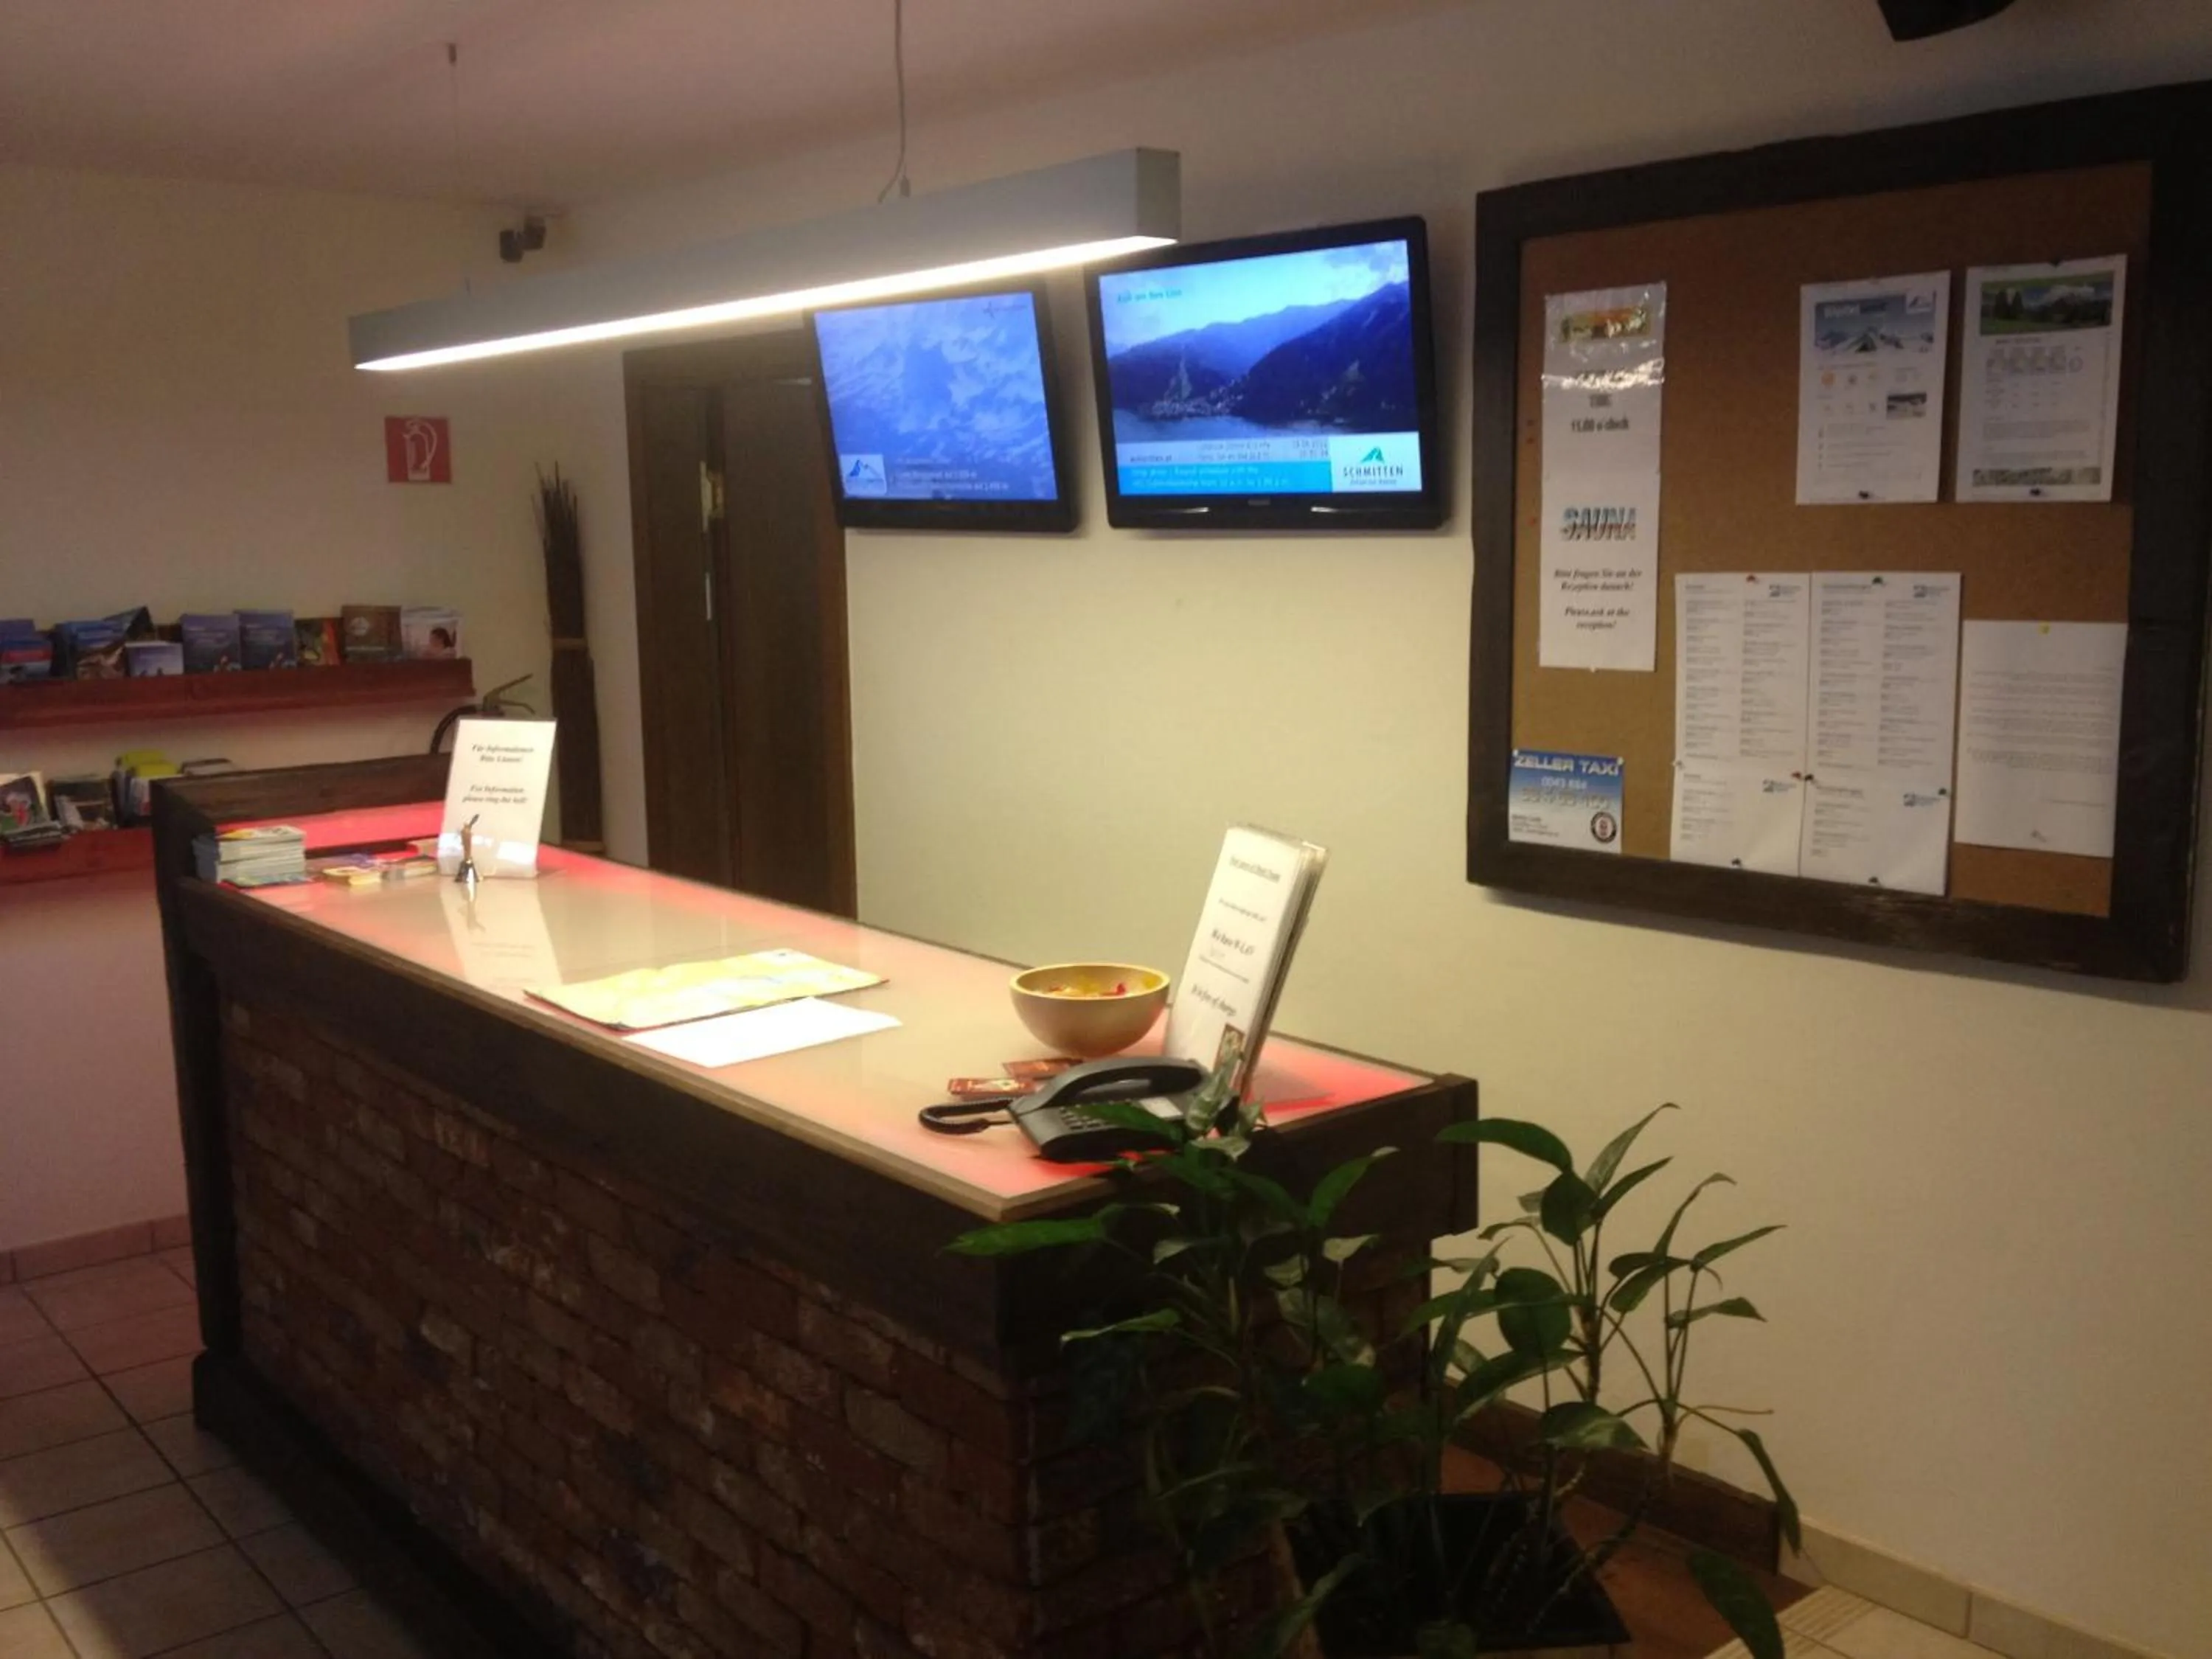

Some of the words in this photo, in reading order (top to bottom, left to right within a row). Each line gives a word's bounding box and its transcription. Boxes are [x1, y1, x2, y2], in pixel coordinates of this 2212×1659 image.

[1343, 465, 1403, 477] SCHMITTEN
[1560, 507, 1636, 541] SAUNA
[1514, 755, 1575, 773] ZELLER
[1578, 759, 1619, 776] TAXI
